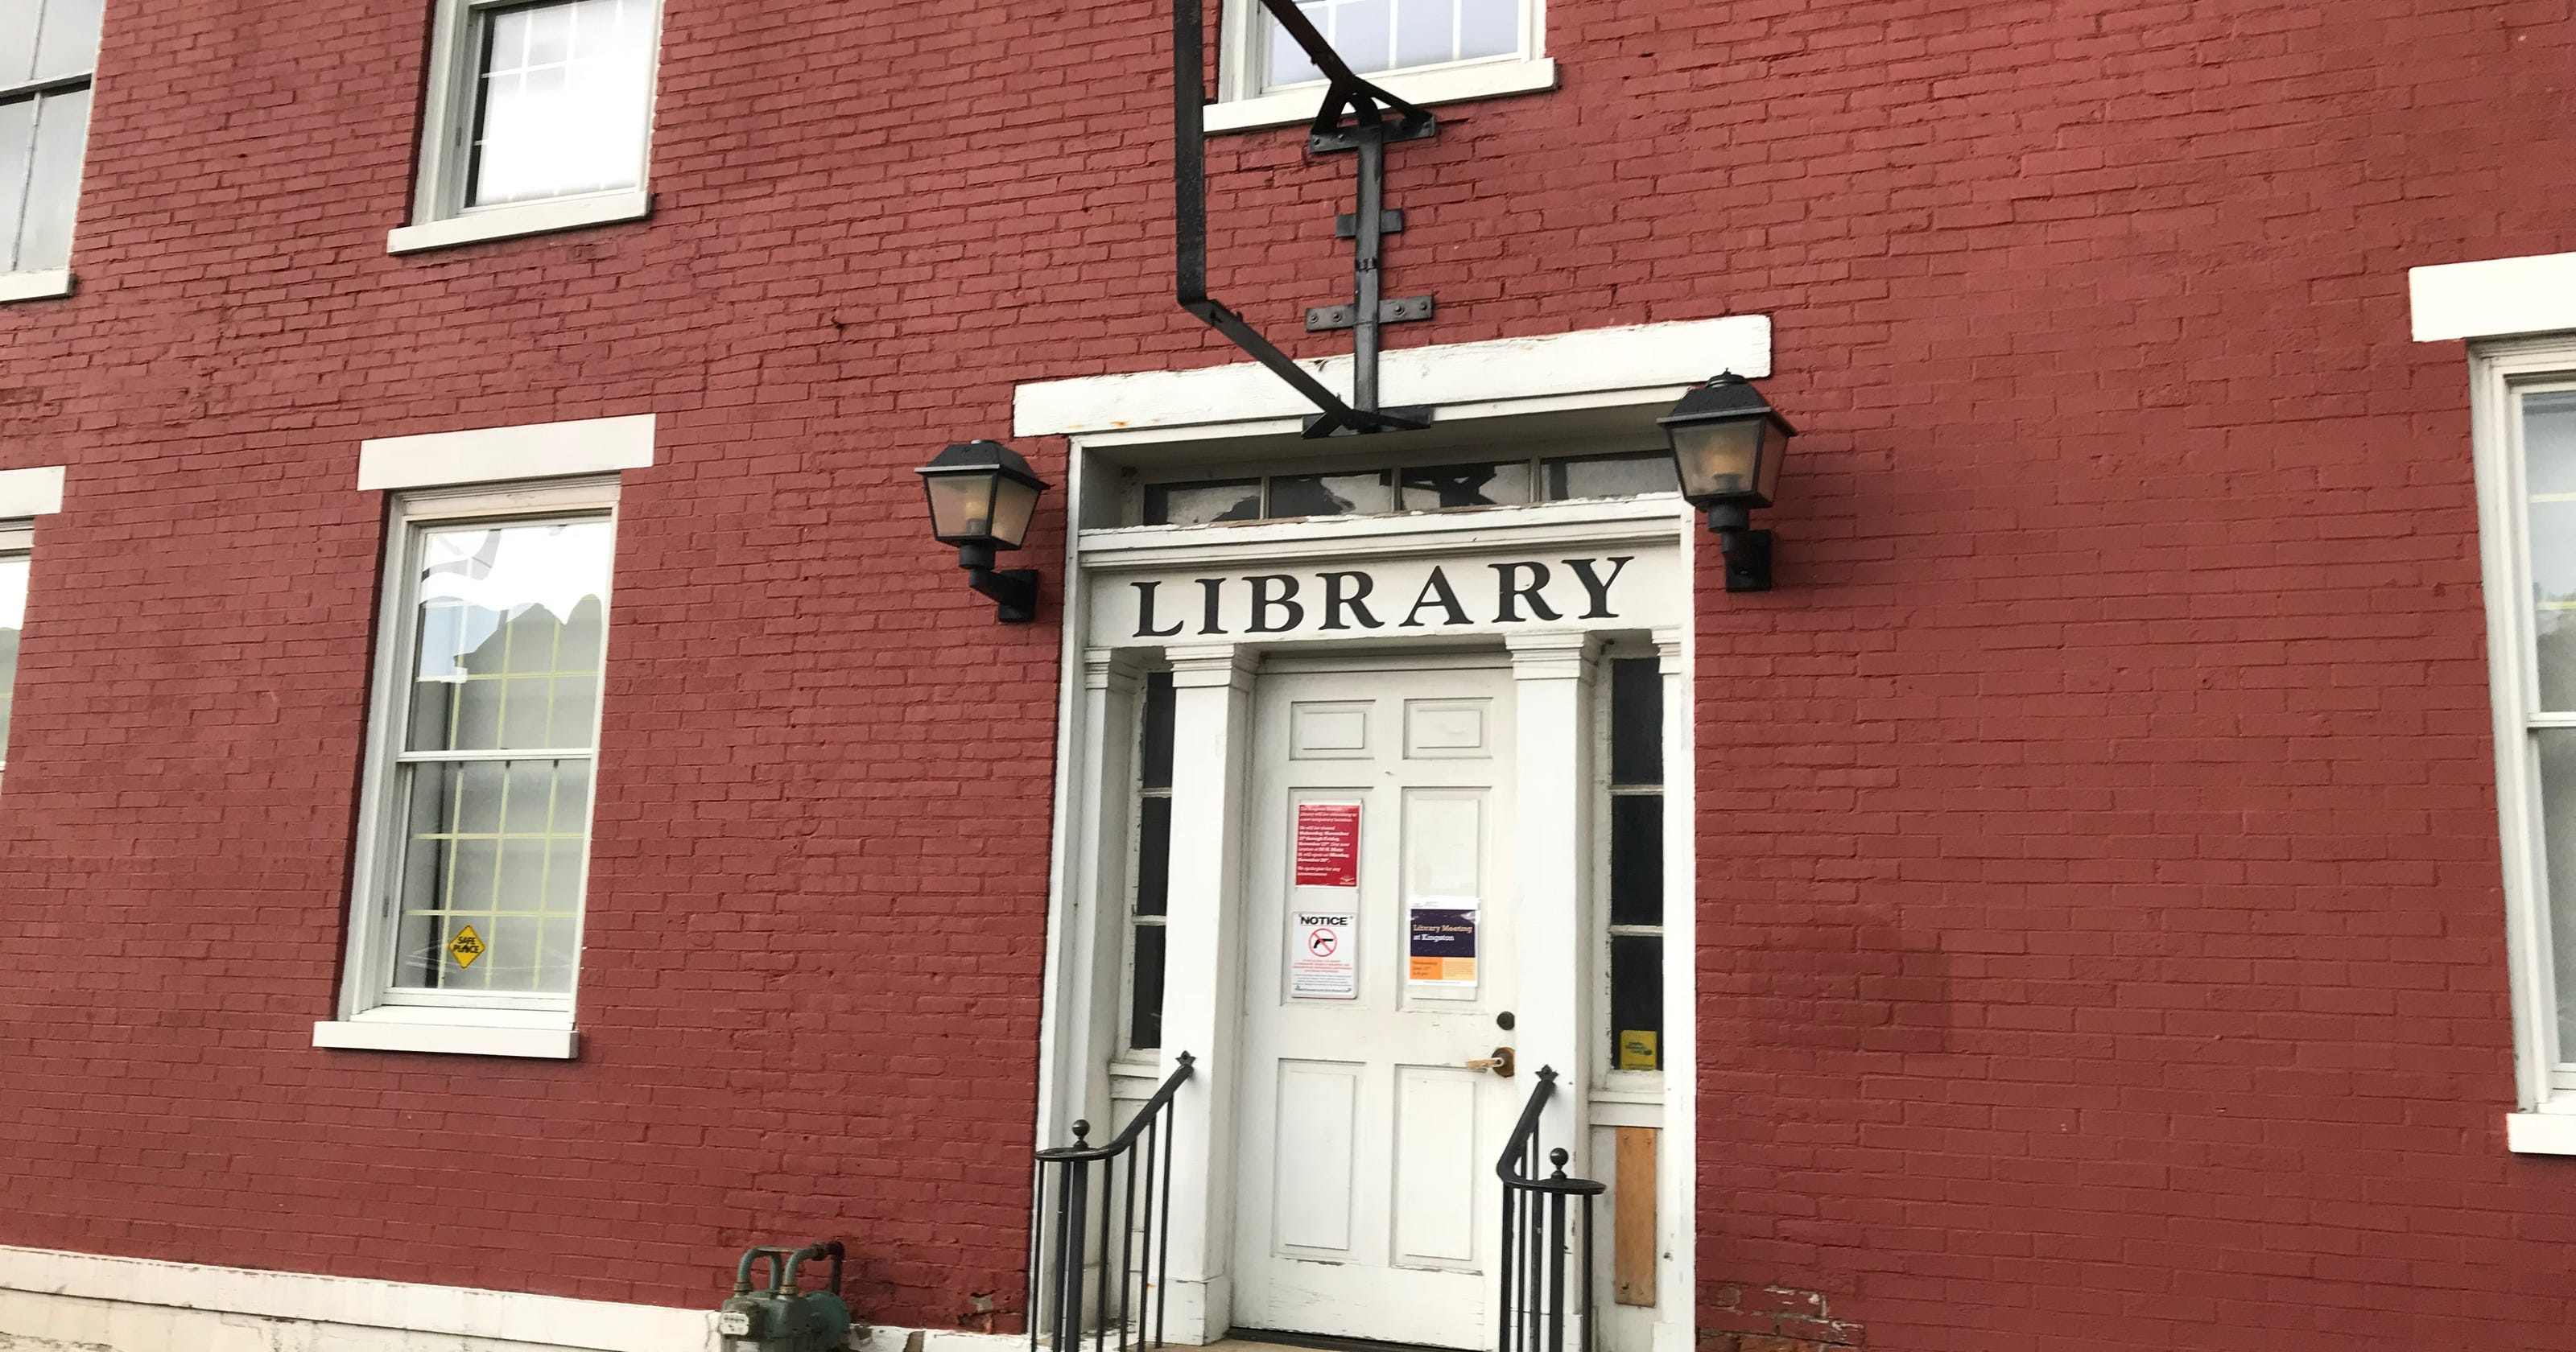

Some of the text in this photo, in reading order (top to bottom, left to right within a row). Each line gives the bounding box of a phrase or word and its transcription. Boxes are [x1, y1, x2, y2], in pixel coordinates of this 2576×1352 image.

[1130, 556, 1634, 637] LIBRARY
[1300, 916, 1348, 925] NOTICE
[1413, 925, 1472, 934] Library Meeting
[458, 936, 476, 945] SAFE
[1422, 934, 1455, 942] Kingston
[453, 944, 480, 954] PLACE
